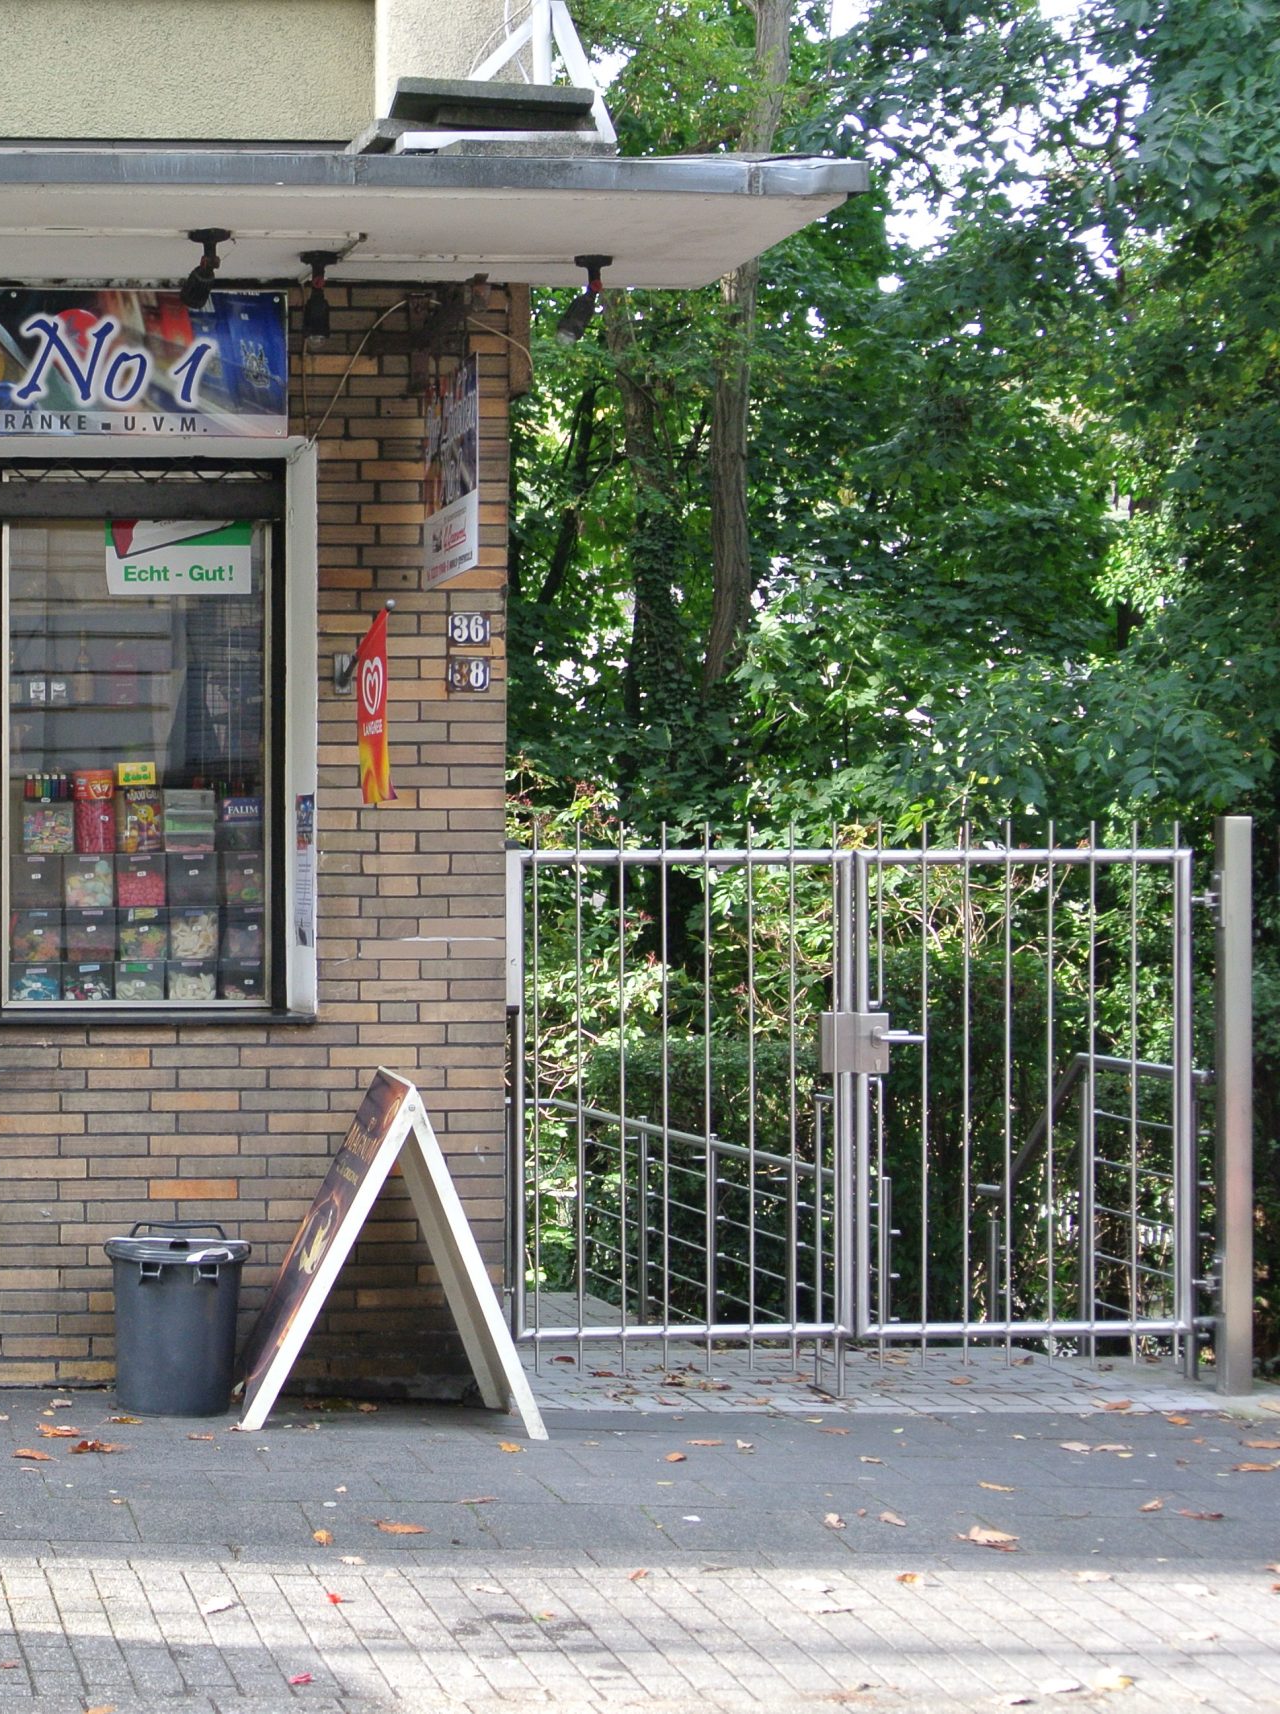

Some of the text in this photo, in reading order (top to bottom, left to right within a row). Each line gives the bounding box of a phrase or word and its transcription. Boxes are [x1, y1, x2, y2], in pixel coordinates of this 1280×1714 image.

[18, 319, 149, 403] No
[173, 342, 213, 403] 1
[124, 416, 210, 433] U.V.M.
[124, 565, 170, 582] Echt
[188, 564, 234, 582] Gut!
[453, 615, 485, 643] 36
[453, 660, 485, 688] 38
[227, 805, 259, 815] FALIM
